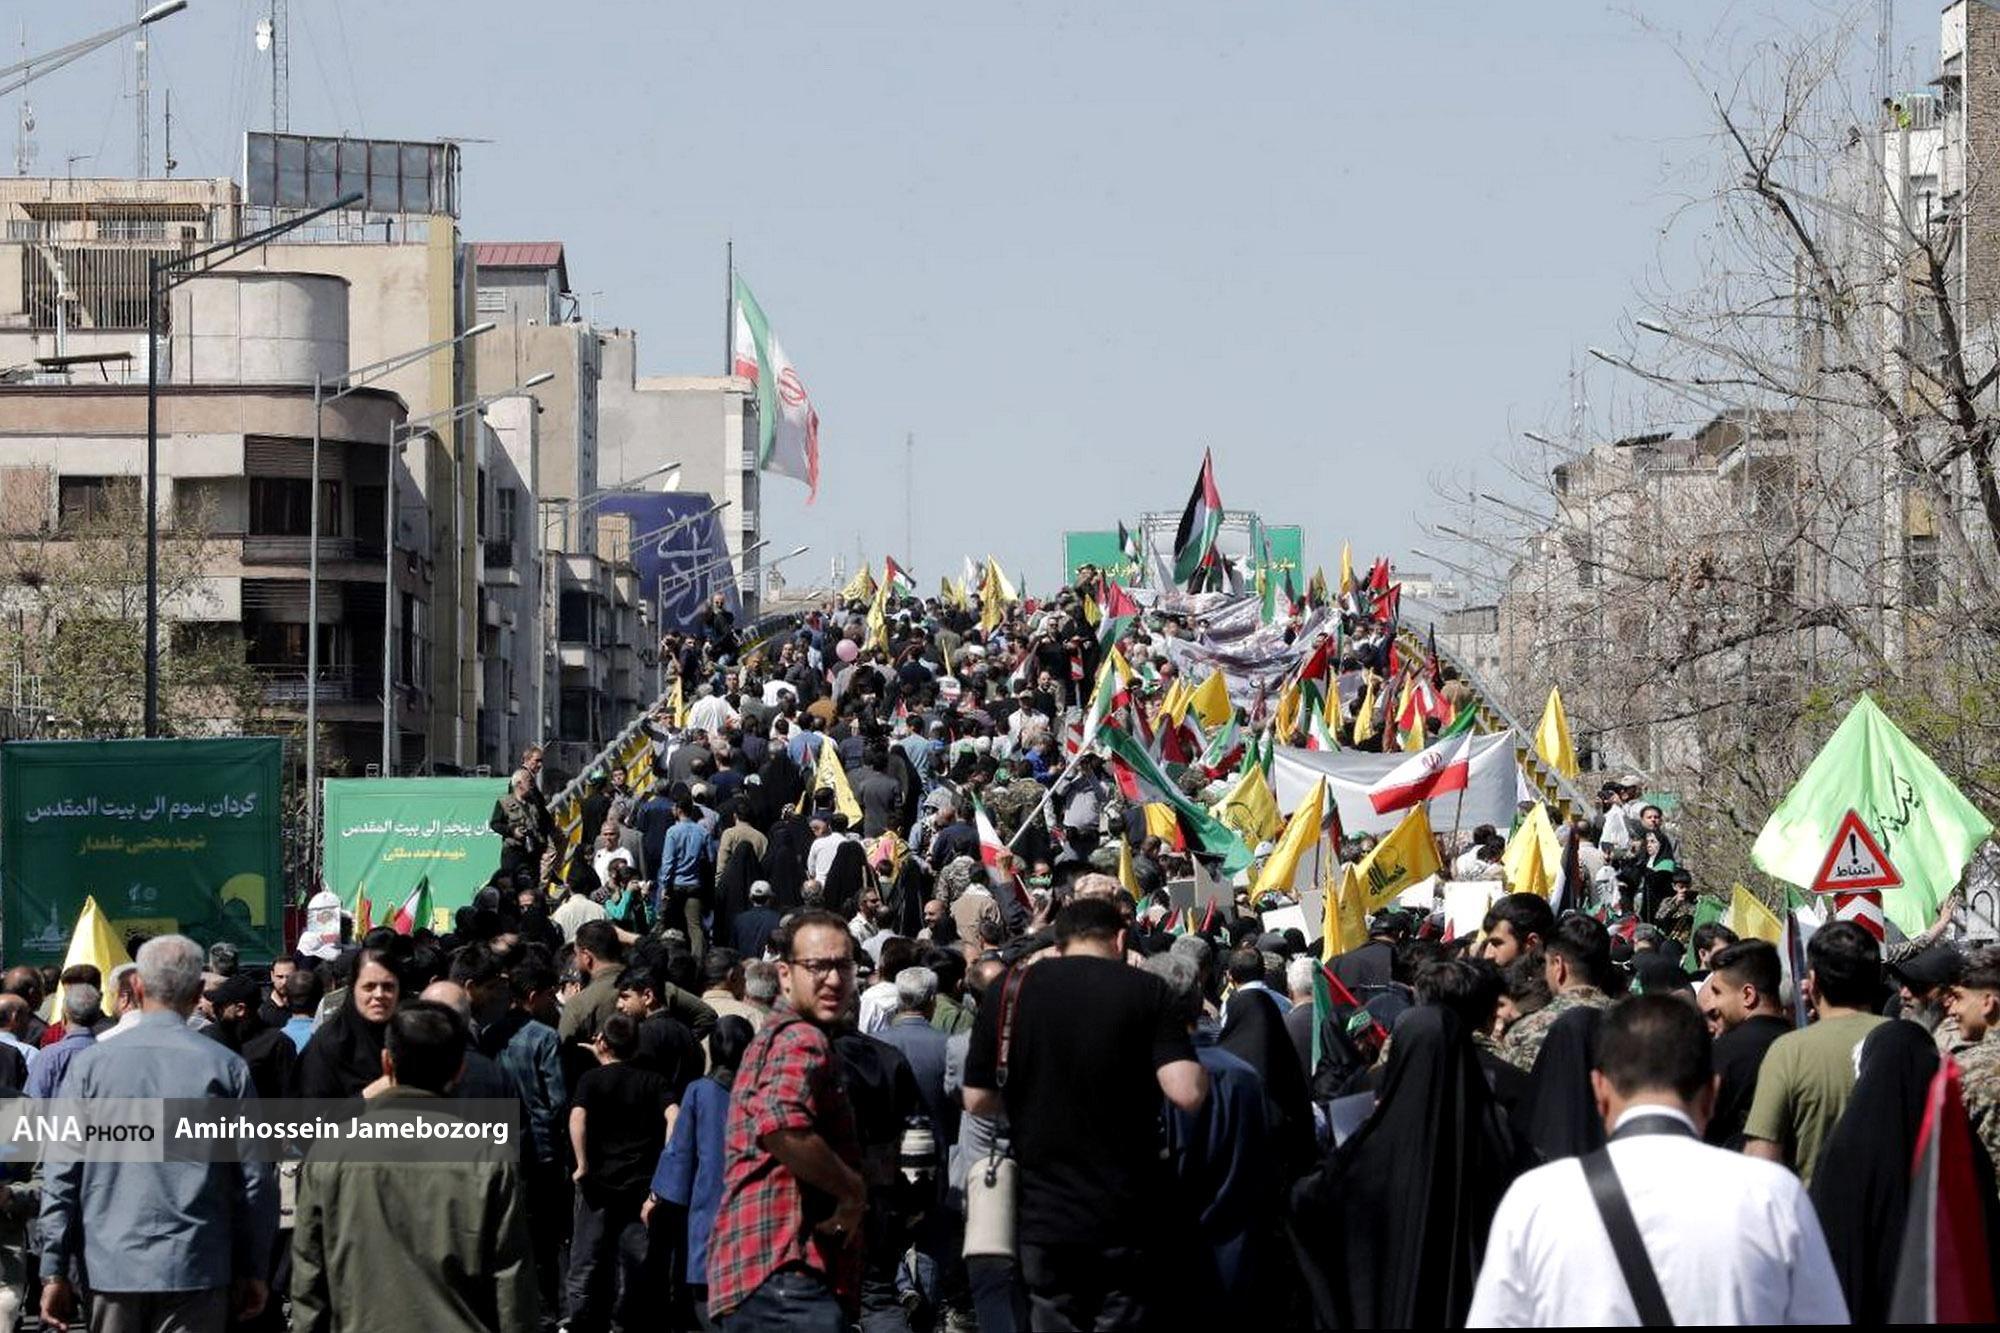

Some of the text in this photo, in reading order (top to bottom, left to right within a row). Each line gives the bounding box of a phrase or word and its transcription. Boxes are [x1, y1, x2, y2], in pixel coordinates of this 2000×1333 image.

[26, 796, 97, 822] المقدس
[100, 799, 135, 819] بیت
[140, 796, 165, 820] الی
[169, 799, 205, 822] سوم
[342, 819, 392, 837] المقدس
[395, 822, 419, 837] بیت
[1836, 862, 1875, 877] احتیاط
